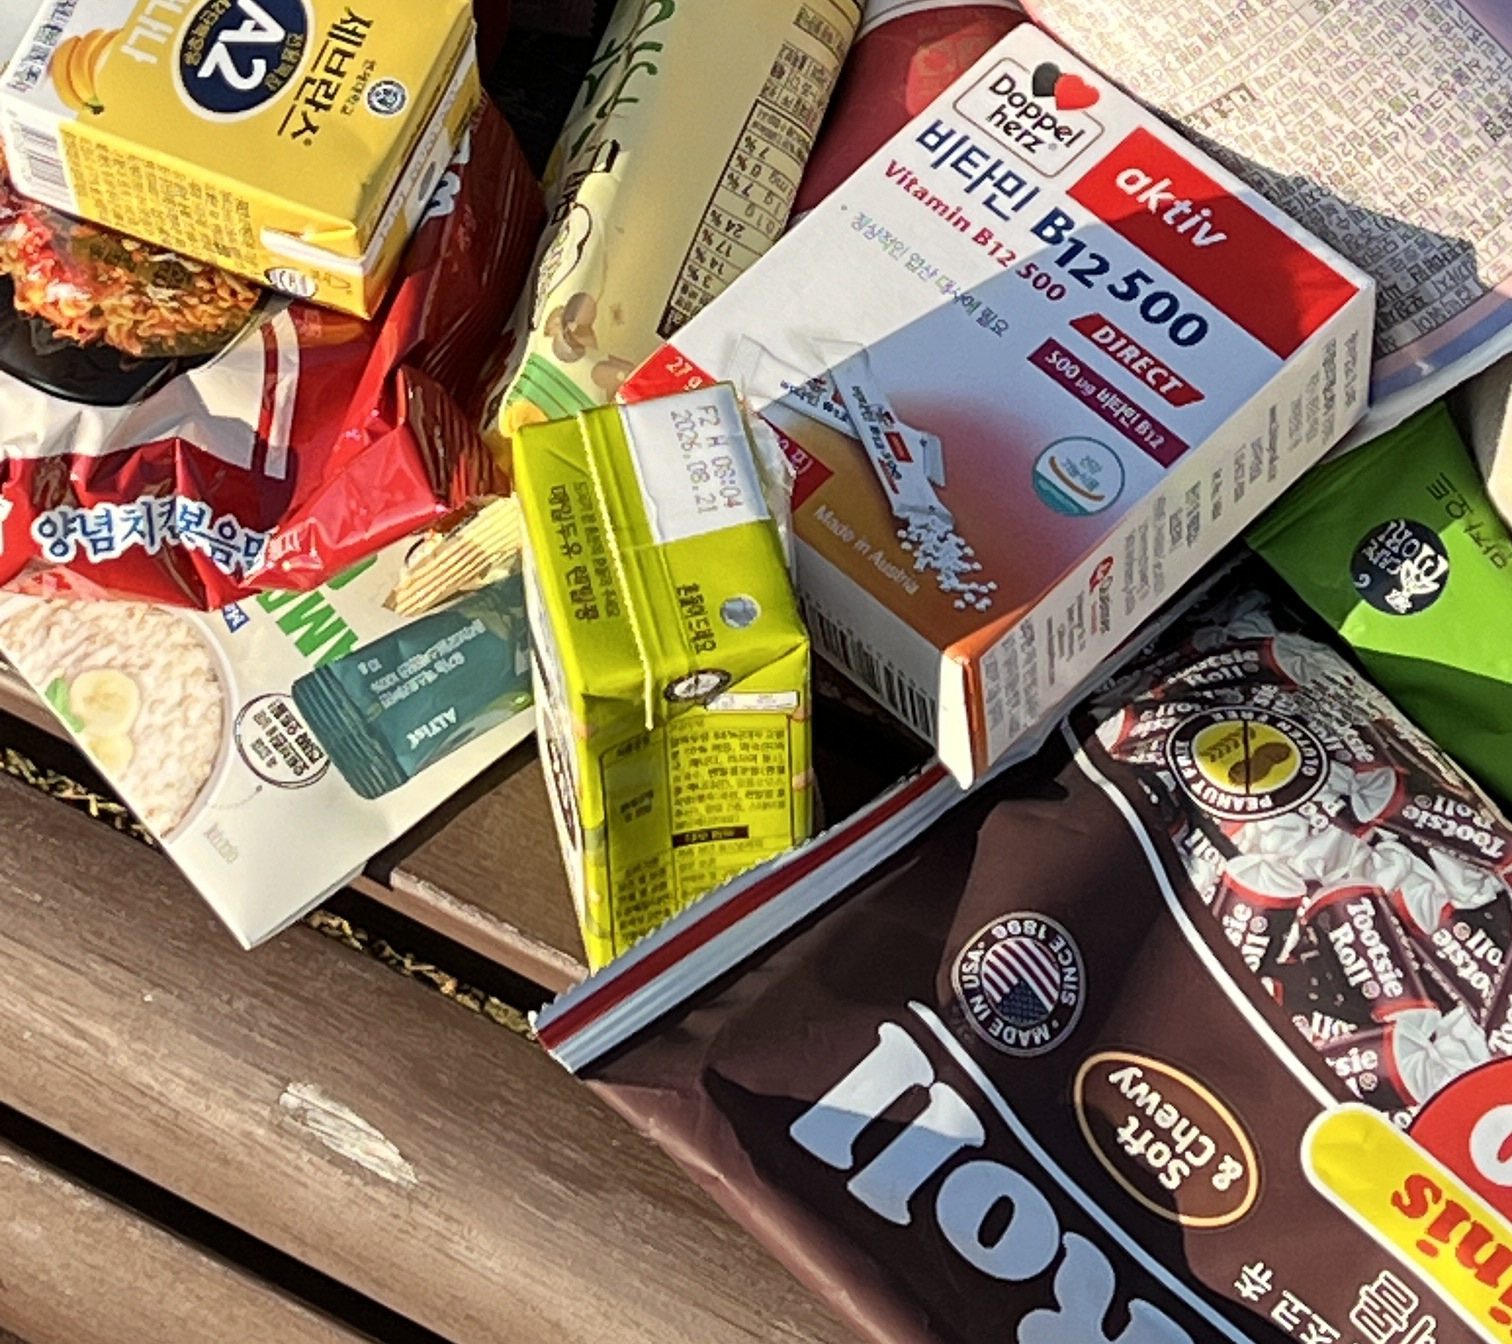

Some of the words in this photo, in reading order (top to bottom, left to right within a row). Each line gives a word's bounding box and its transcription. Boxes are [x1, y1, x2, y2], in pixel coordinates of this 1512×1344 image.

[270, 4, 380, 152] 세브란스
[983, 69, 1086, 155] Doppel
[984, 102, 1048, 157] herz
[879, 157, 976, 236] Vitamin
[967, 224, 1020, 271] B12
[1012, 256, 1070, 307] 500
[906, 111, 1042, 229] 비타민
[1021, 202, 1121, 294] B12
[1103, 259, 1216, 357] 500
[1111, 153, 1235, 258] aktiv
[664, 353, 695, 382] 27
[1041, 346, 1082, 383] 500
[1088, 321, 1187, 402] DIRECT
[810, 503, 860, 547] Made
[1272, 714, 1316, 776] GLUTEN
[1190, 776, 1271, 810] PEANUT
[1399, 799, 1507, 857] Tootsie
[963, 948, 985, 987] USA
[1046, 933, 1073, 1006] SINCE
[1327, 922, 1374, 988] Roll
[1344, 893, 1408, 997] Tootsie
[962, 989, 997, 1024] IN
[987, 1013, 1049, 1043] MADE
[1101, 1054, 1224, 1172] Chewy
[1108, 1109, 1195, 1193] Soft
[1203, 1150, 1247, 1194] &
[1228, 1249, 1285, 1307] 츄
